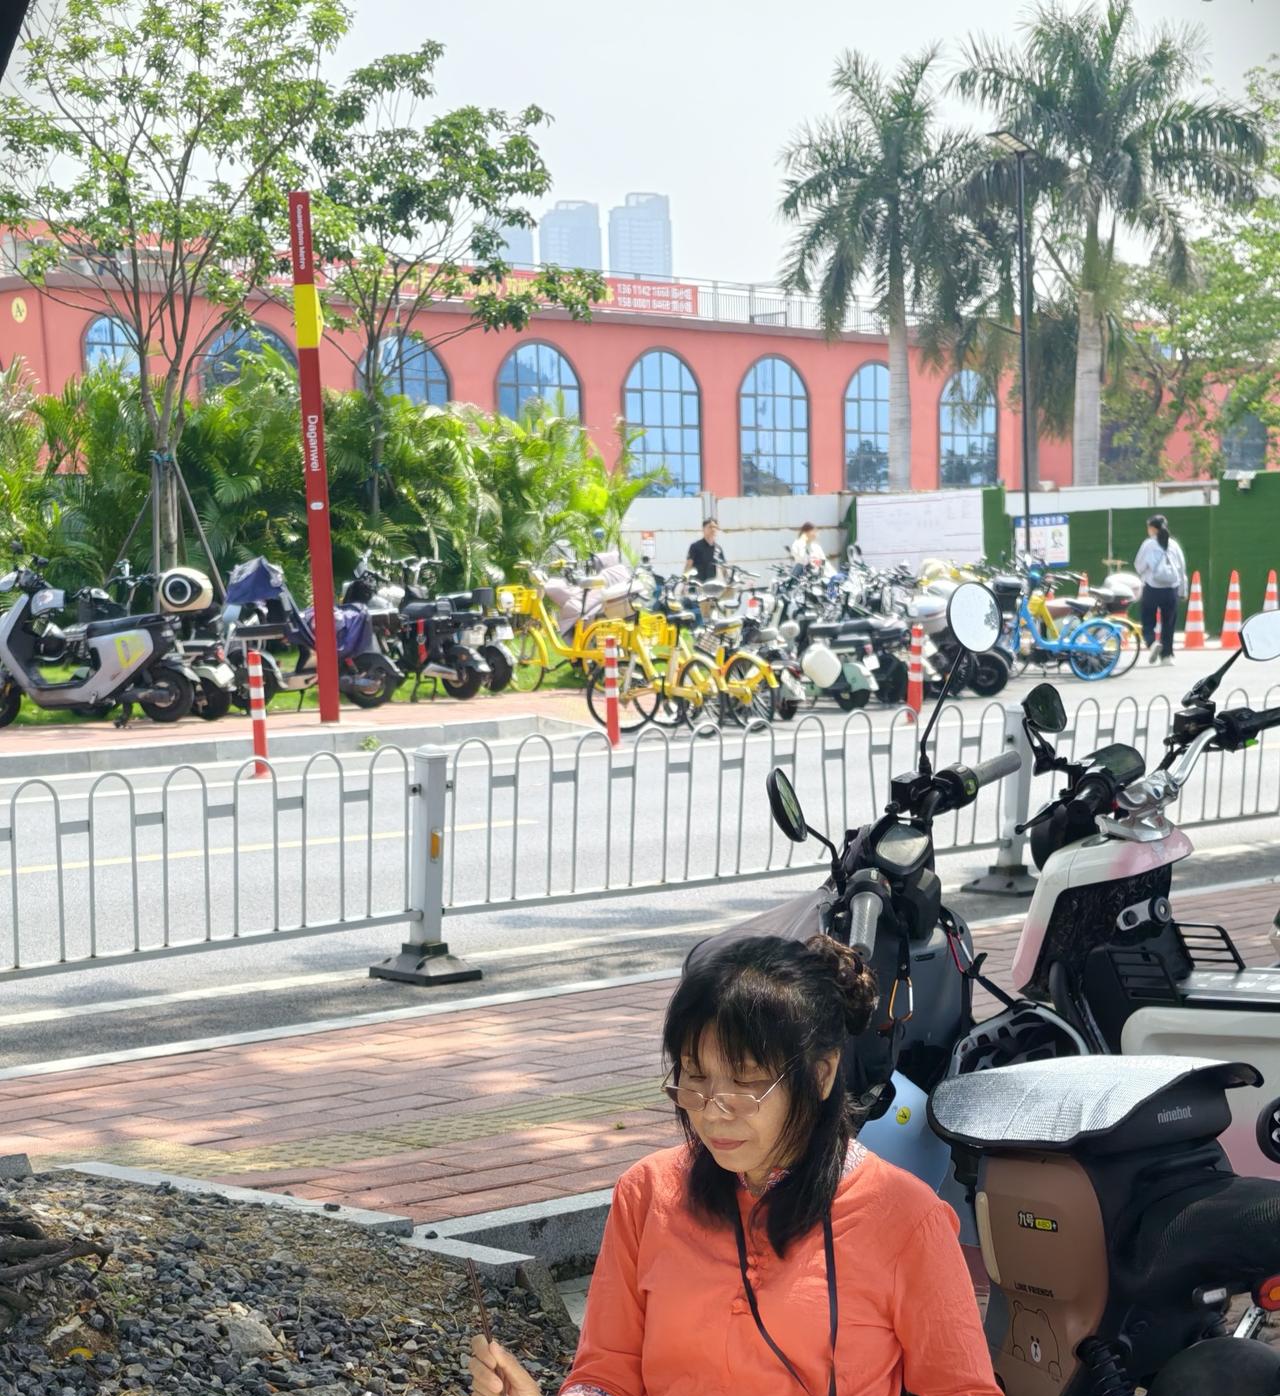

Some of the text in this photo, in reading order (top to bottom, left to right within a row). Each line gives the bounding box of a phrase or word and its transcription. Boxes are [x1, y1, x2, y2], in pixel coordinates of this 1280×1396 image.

[296, 204, 304, 245] Guangzhou
[306, 415, 320, 471] Daganwei
[1157, 1105, 1192, 1124] ninebot
[1019, 1211, 1034, 1227] 九号
